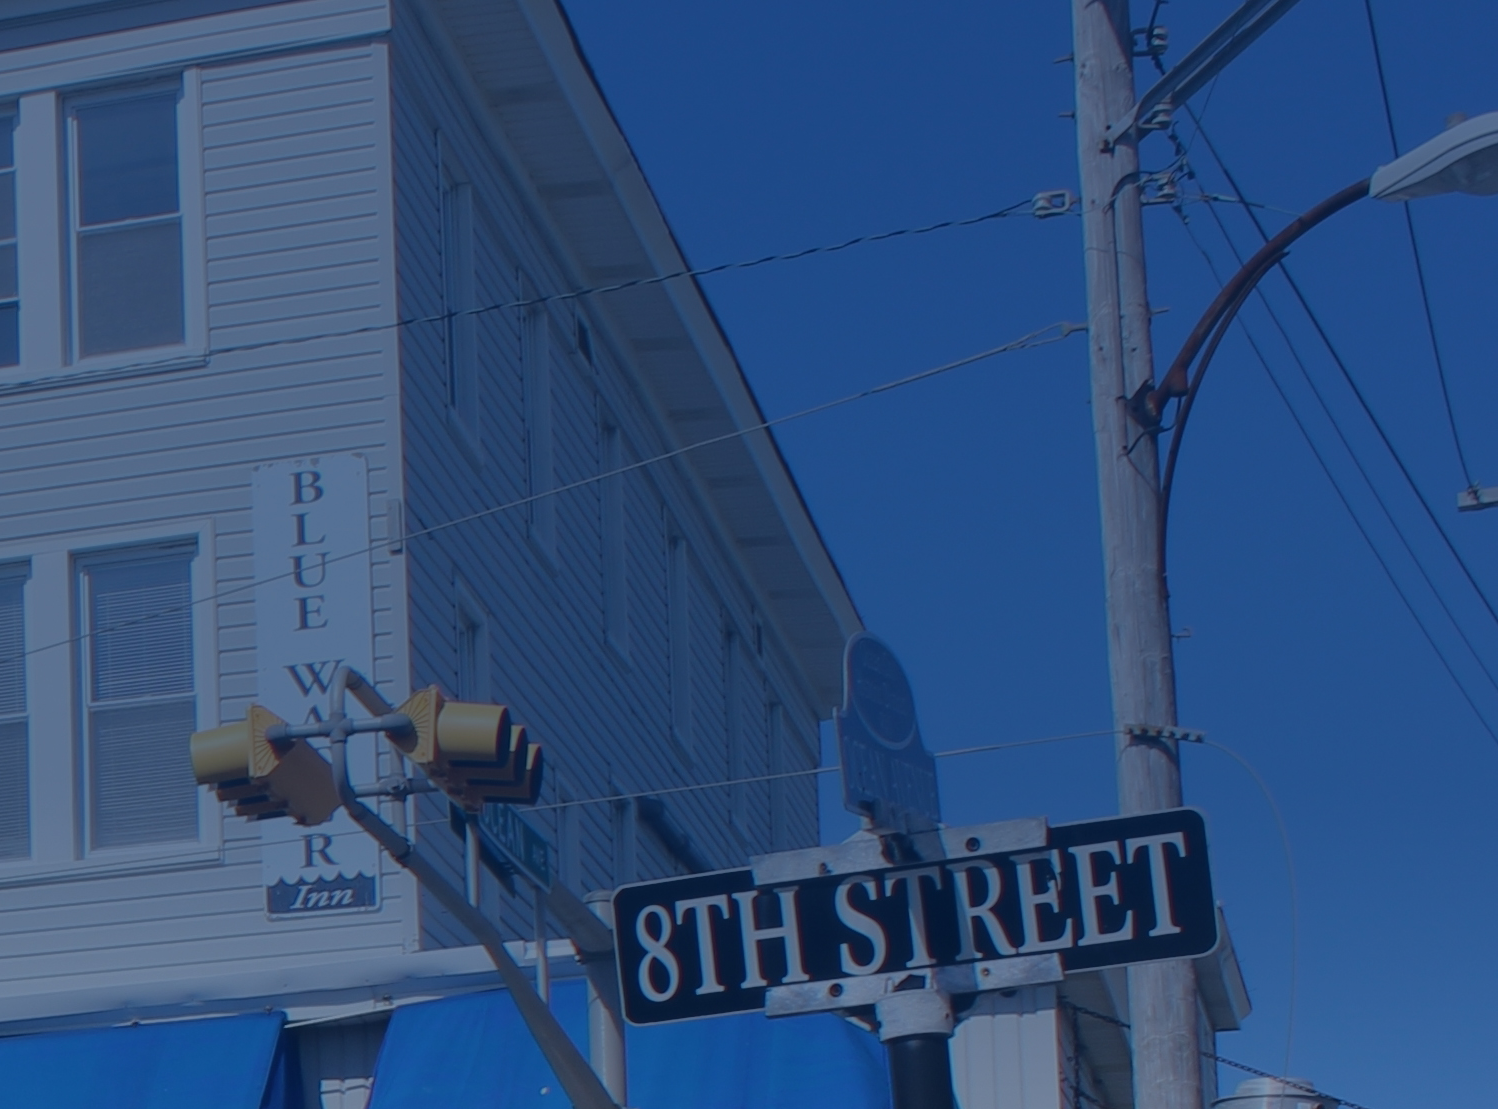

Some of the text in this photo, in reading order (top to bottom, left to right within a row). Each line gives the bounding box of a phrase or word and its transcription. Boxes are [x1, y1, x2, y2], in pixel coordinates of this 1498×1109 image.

[289, 469, 329, 633] BLUE
[289, 884, 355, 910] Inn
[635, 831, 1189, 1003] 8TH STREET
